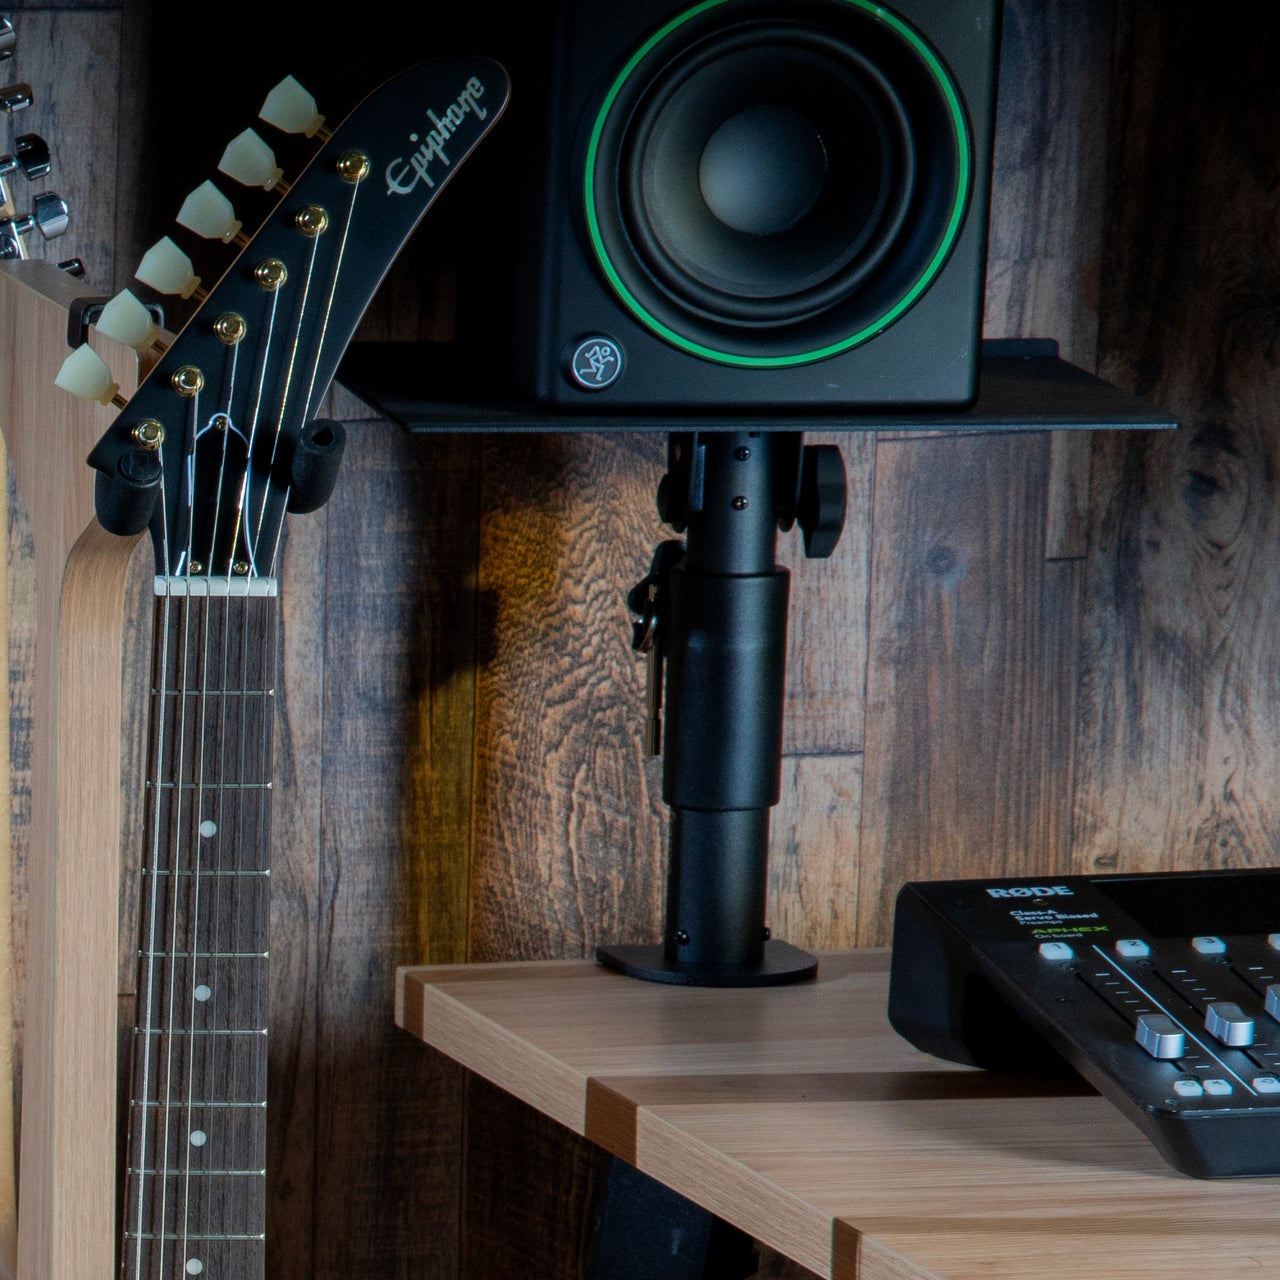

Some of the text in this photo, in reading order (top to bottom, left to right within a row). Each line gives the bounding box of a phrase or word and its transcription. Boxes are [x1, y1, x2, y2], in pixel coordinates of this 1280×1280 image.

[385, 76, 486, 196] Epiphone
[986, 886, 1074, 898] RØDE
[1031, 925, 1109, 934] APHEX
